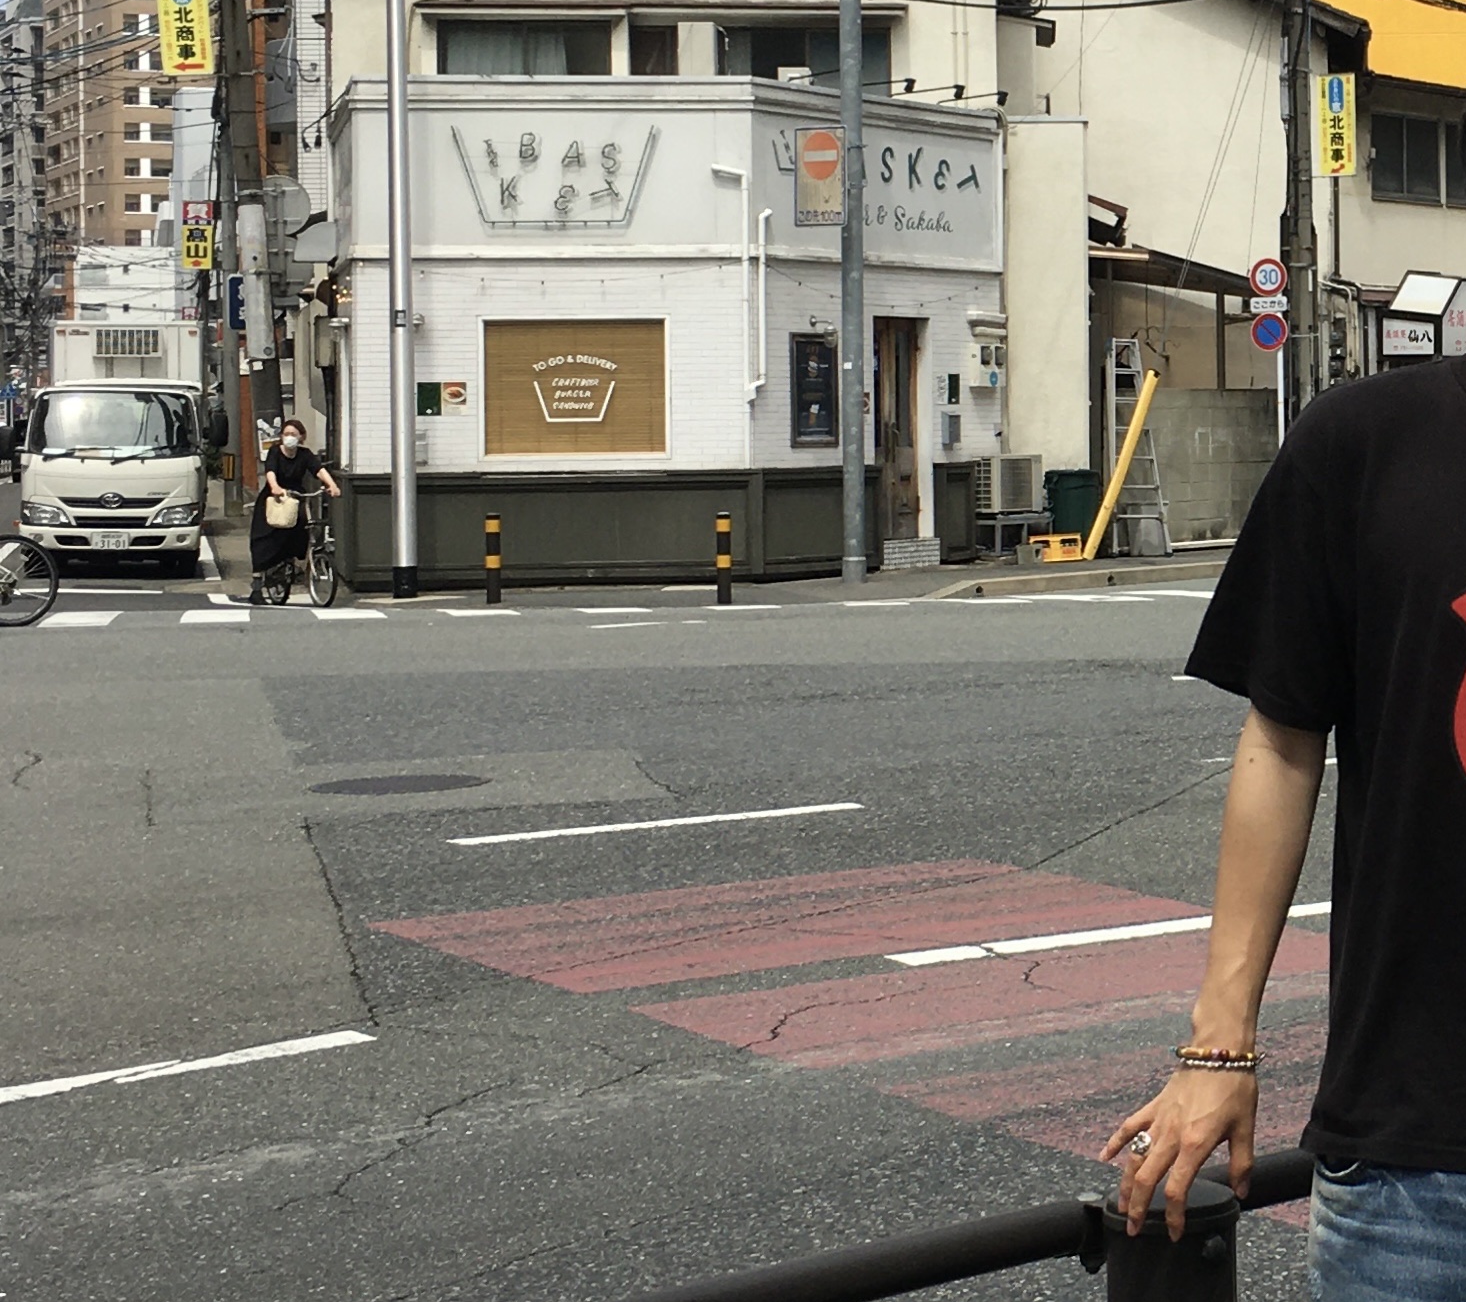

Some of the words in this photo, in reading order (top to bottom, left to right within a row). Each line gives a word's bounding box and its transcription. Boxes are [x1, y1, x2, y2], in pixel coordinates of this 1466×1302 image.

[173, 6, 196, 61] 北商事
[1329, 115, 1345, 163] 北商事
[894, 204, 954, 233] Sakaba
[1258, 268, 1279, 286] 30
[1252, 299, 1287, 310] ここから
[532, 361, 547, 372] TO
[548, 355, 565, 367] GO
[566, 354, 575, 363] &
[576, 354, 618, 372] DELIVERY
